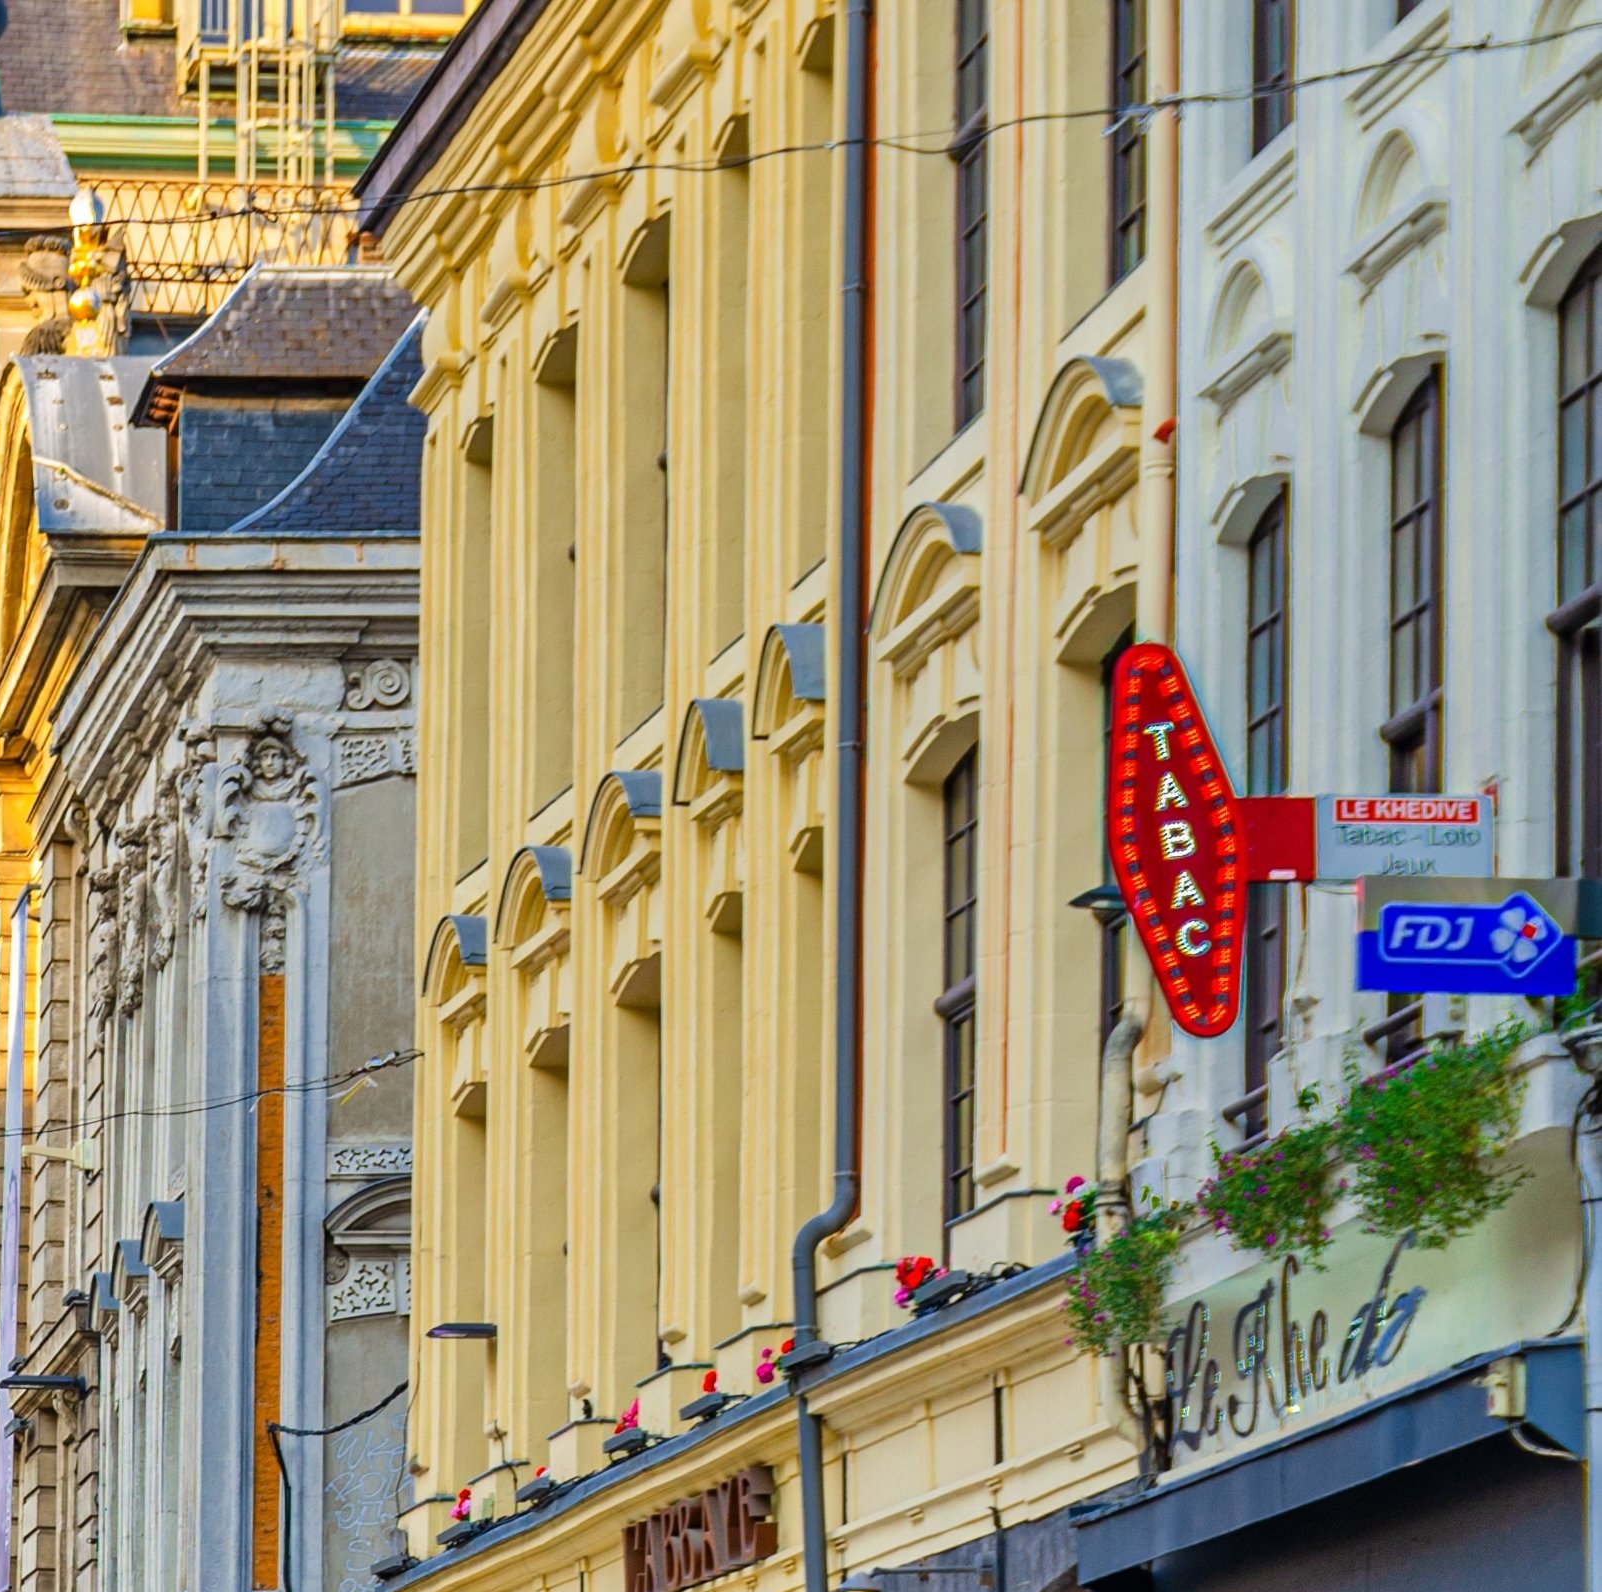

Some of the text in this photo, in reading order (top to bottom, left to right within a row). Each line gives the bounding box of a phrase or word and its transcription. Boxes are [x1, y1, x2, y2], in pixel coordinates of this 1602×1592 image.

[1341, 800, 1473, 819] LE KHEDIVE
[1143, 721, 1213, 958] TABAC
[1333, 825, 1405, 846] Tabac
[1428, 825, 1481, 847] Loto
[1378, 853, 1438, 875] Jeux
[1389, 916, 1474, 950] FDJ
